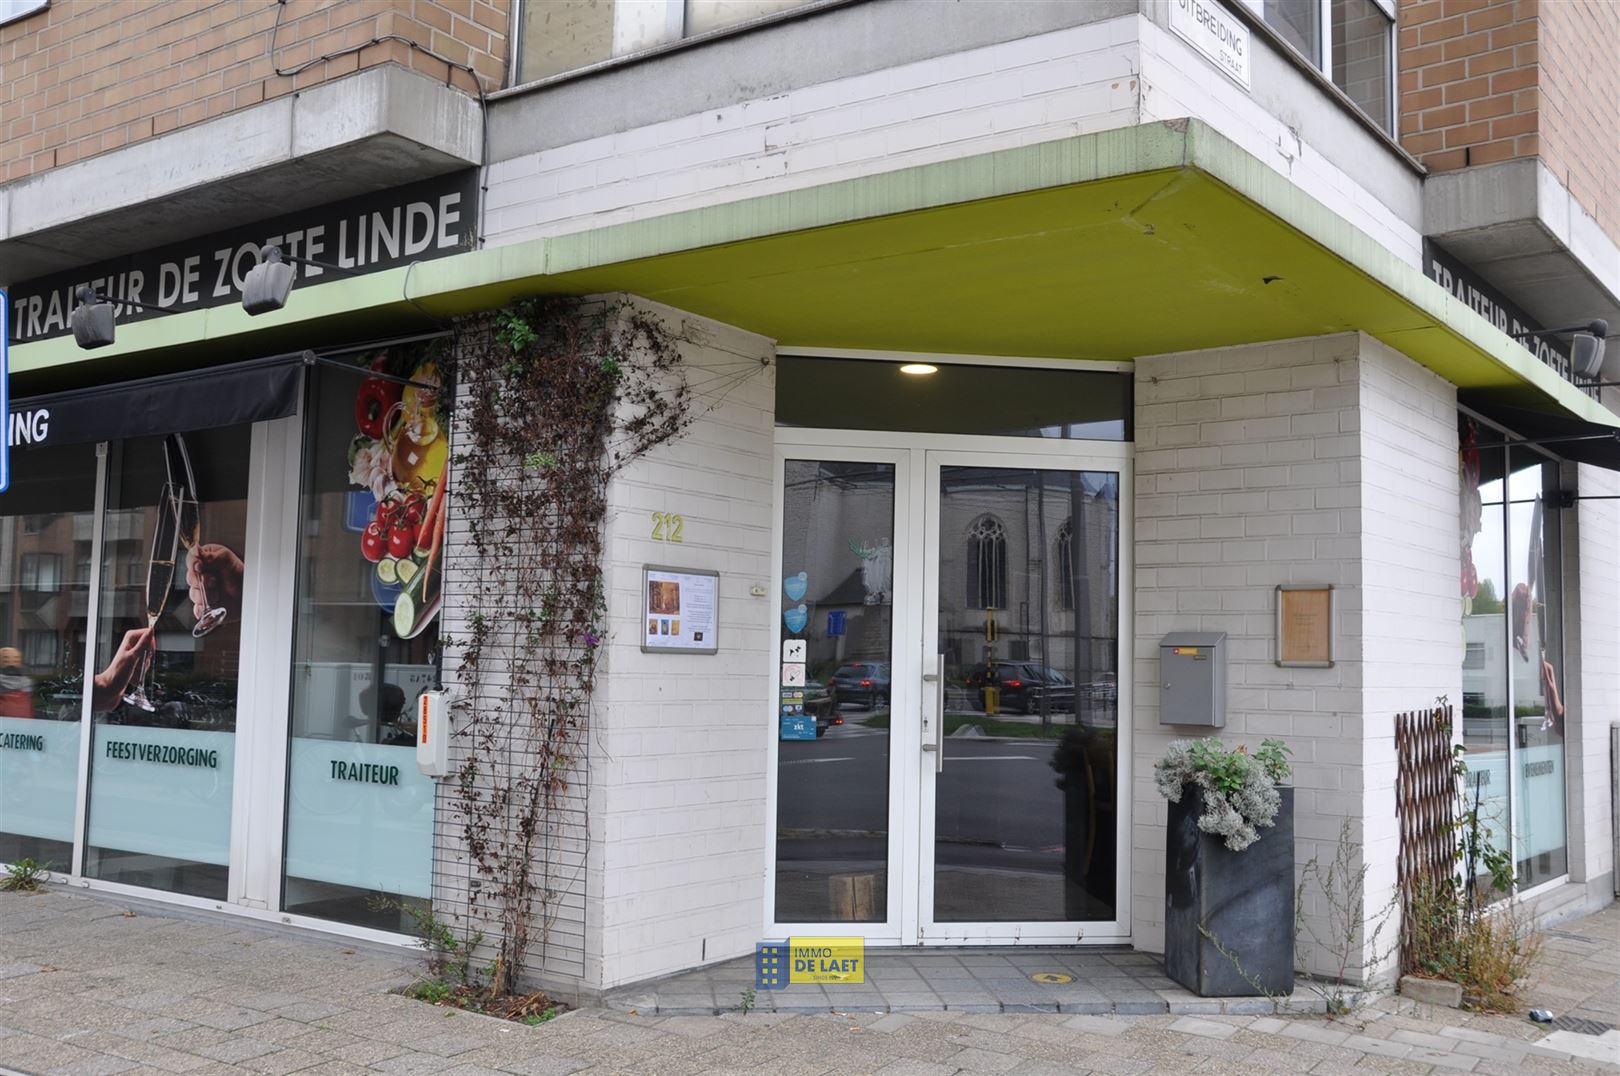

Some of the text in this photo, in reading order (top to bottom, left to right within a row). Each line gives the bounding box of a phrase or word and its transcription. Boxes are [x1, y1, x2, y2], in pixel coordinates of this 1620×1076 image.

[158, 255, 200, 308] DE
[212, 225, 325, 297] ZOTE
[338, 192, 461, 268] LINDE
[651, 511, 684, 543] 212
[106, 740, 218, 769] FEESTVERZORGING
[330, 760, 400, 786] TRAITEUR
